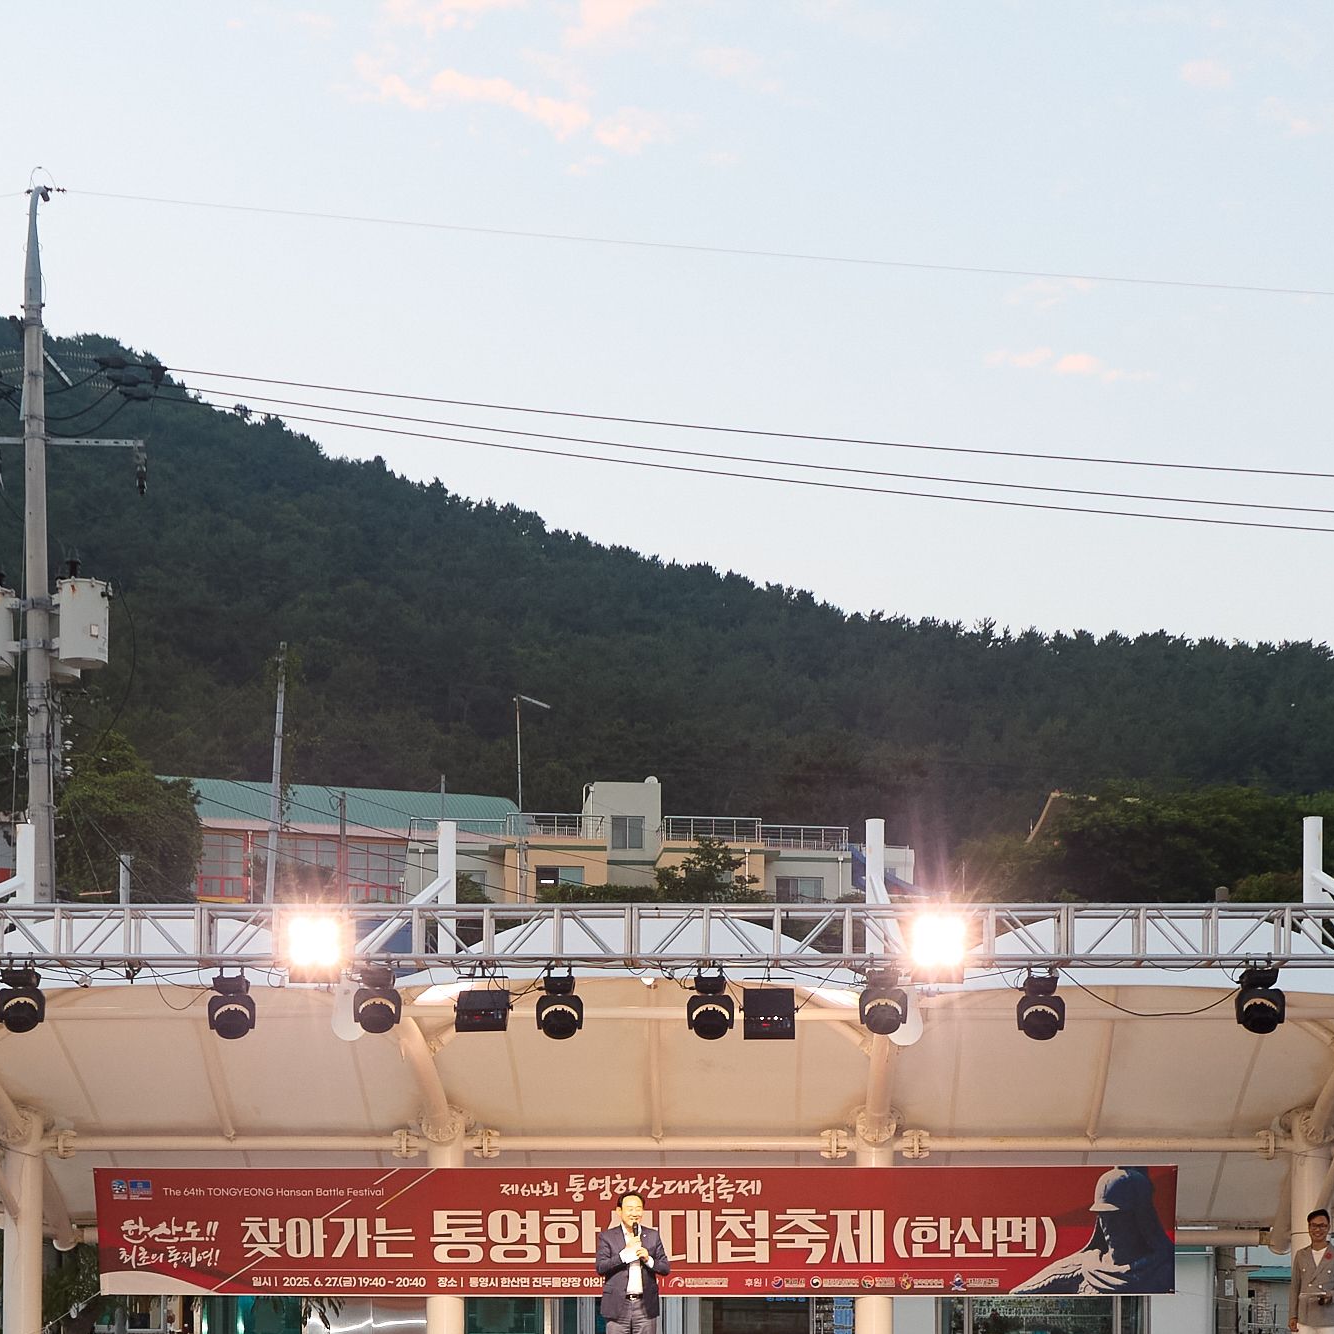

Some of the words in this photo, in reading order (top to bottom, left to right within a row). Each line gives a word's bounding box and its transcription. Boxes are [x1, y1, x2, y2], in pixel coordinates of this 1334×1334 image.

[162, 1187, 181, 1197] The
[183, 1187, 205, 1197] 64th
[207, 1187, 274, 1198] TONGYEONG
[276, 1187, 314, 1197] Hansan
[316, 1187, 344, 1197] Battle
[347, 1187, 385, 1197] Festival
[500, 1180, 559, 1197] 제64회
[565, 1173, 763, 1203] 통영한산대첩축제
[120, 1216, 219, 1244] 한산도!!
[240, 1216, 416, 1259] 찾아가는
[429, 1208, 885, 1264] 통영한대첩축제
[892, 1216, 1057, 1258] (한산면)
[252, 1276, 272, 1287] 일시
[282, 1276, 312, 1287] 2025.
[314, 1276, 323, 1287] 6.
[358, 1276, 386, 1287] 19:40
[395, 1276, 426, 1287] 20:40
[437, 1276, 458, 1288] 장소
[468, 1276, 499, 1288] 통영시
[500, 1276, 530, 1288] 한산면
[582, 1276, 606, 1288] 야외
[744, 1277, 763, 1288] 후원
